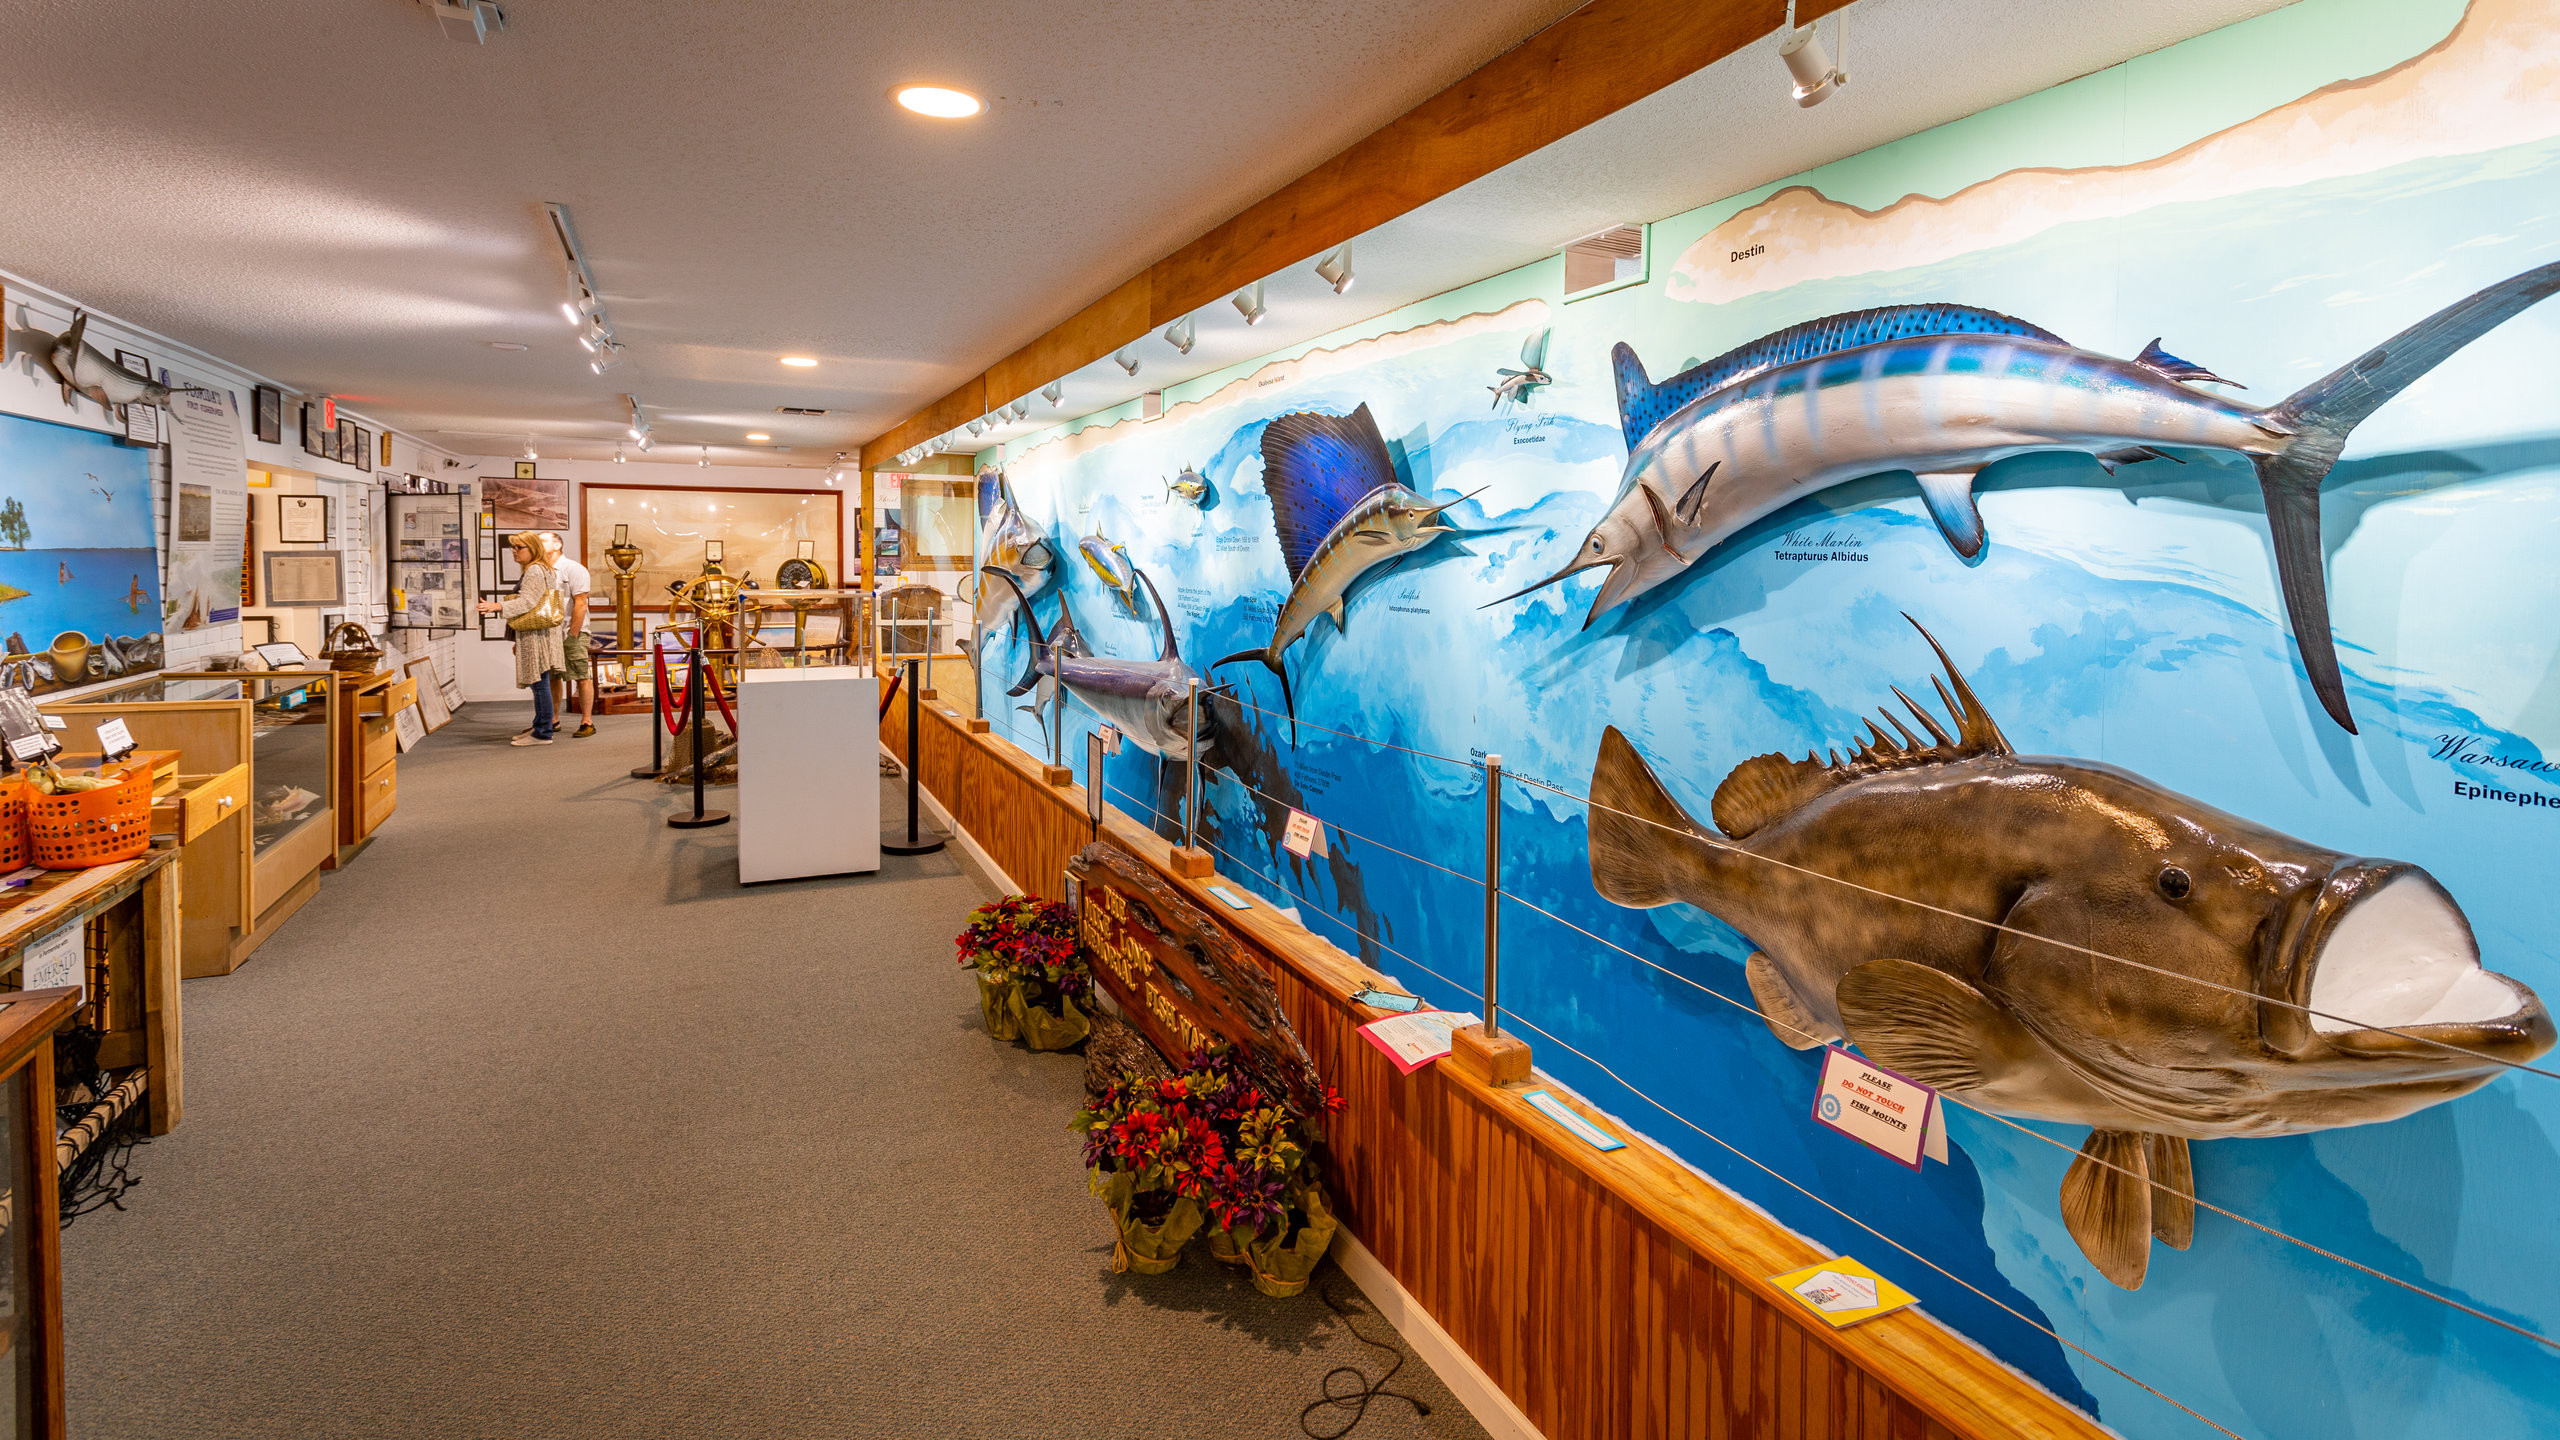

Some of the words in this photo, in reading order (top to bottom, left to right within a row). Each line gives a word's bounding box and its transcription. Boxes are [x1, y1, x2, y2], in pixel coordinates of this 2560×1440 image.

[1731, 244, 1764, 262] Destin
[1506, 418, 1532, 435] Flying
[1535, 413, 1556, 428] Fish
[1782, 530, 1812, 547] White
[1816, 531, 1864, 547] Marlin
[1774, 550, 1828, 562] Tetrapturus
[1830, 552, 1868, 562] Albidus
[2431, 734, 2560, 772] Warsaw
[1470, 772, 1485, 784] 360ft
[1546, 780, 1564, 792] Pass
[2454, 781, 2560, 808] Epinephe
[1104, 884, 1128, 924] THE
[1120, 928, 1154, 976] LONG
[34, 952, 76, 988] EMERALD
[1146, 981, 1179, 1033] FISH
[1861, 1072, 1893, 1090] PLEASE
[1842, 1079, 1854, 1089] DO
[1856, 1086, 1874, 1098] NOT
[1876, 1094, 1905, 1112] TOUCH
[1851, 1099, 1870, 1112] FISH
[1871, 1109, 1908, 1130] MOUNTS
[1821, 1286, 1842, 1300] 21
